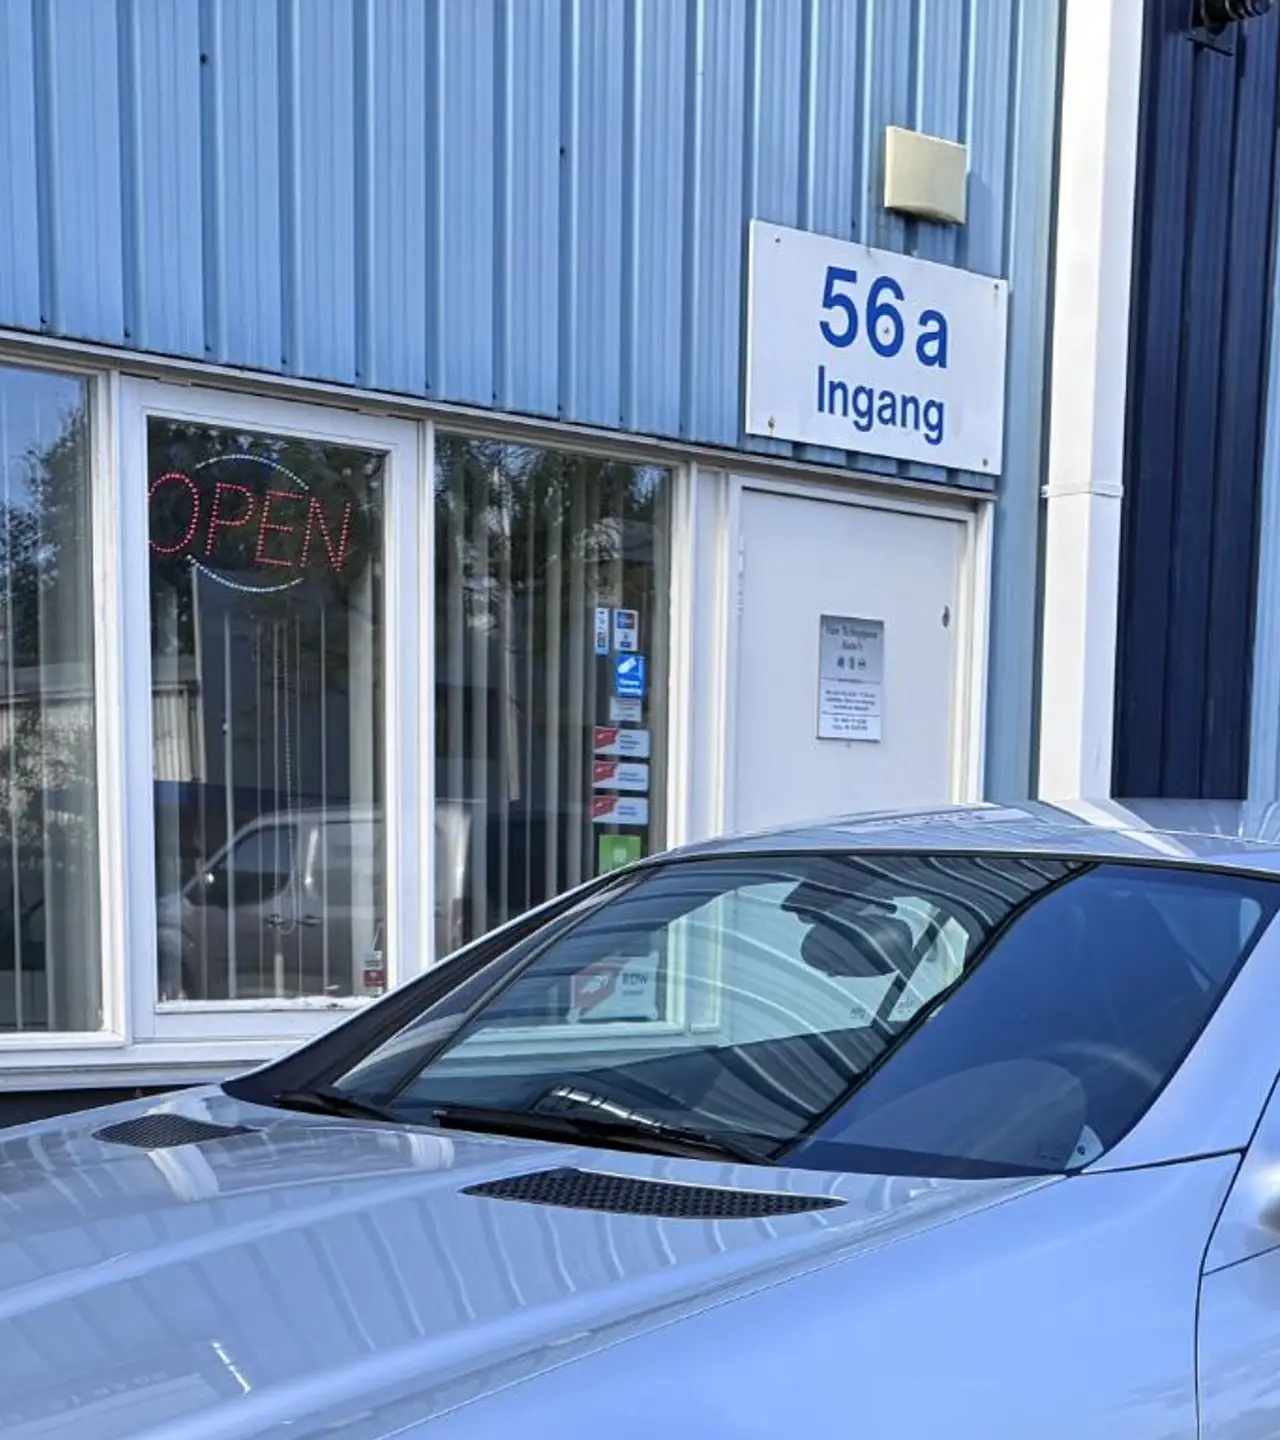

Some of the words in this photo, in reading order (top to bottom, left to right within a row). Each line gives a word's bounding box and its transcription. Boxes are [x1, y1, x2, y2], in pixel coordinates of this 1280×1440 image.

[819, 266, 948, 369] 56a
[817, 365, 945, 446] Ingang
[148, 469, 352, 572] OPEN
